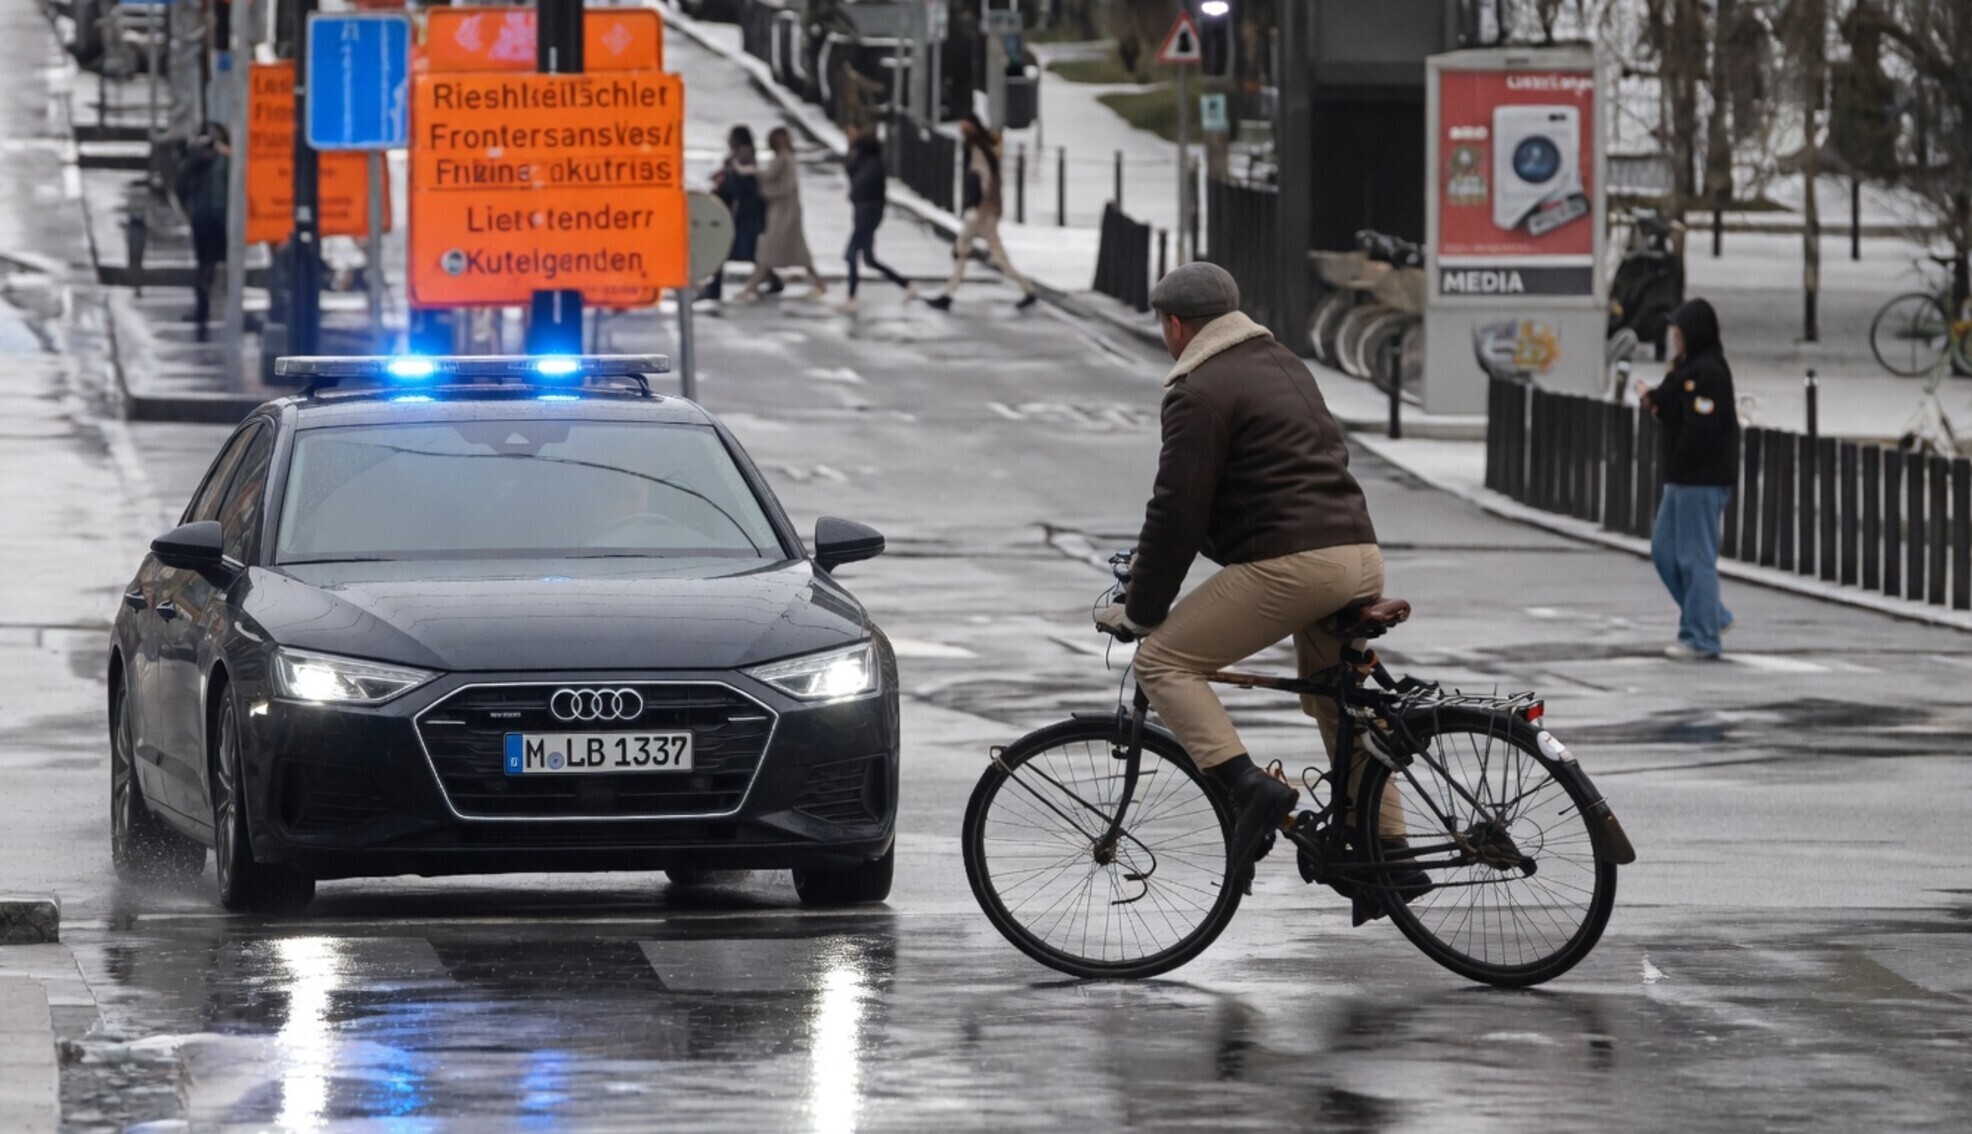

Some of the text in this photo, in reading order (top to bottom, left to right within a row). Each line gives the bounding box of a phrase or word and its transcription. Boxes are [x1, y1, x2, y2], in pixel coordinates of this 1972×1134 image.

[1443, 271, 1524, 292] MEDIA
[526, 736, 688, 768] M LB 1337
